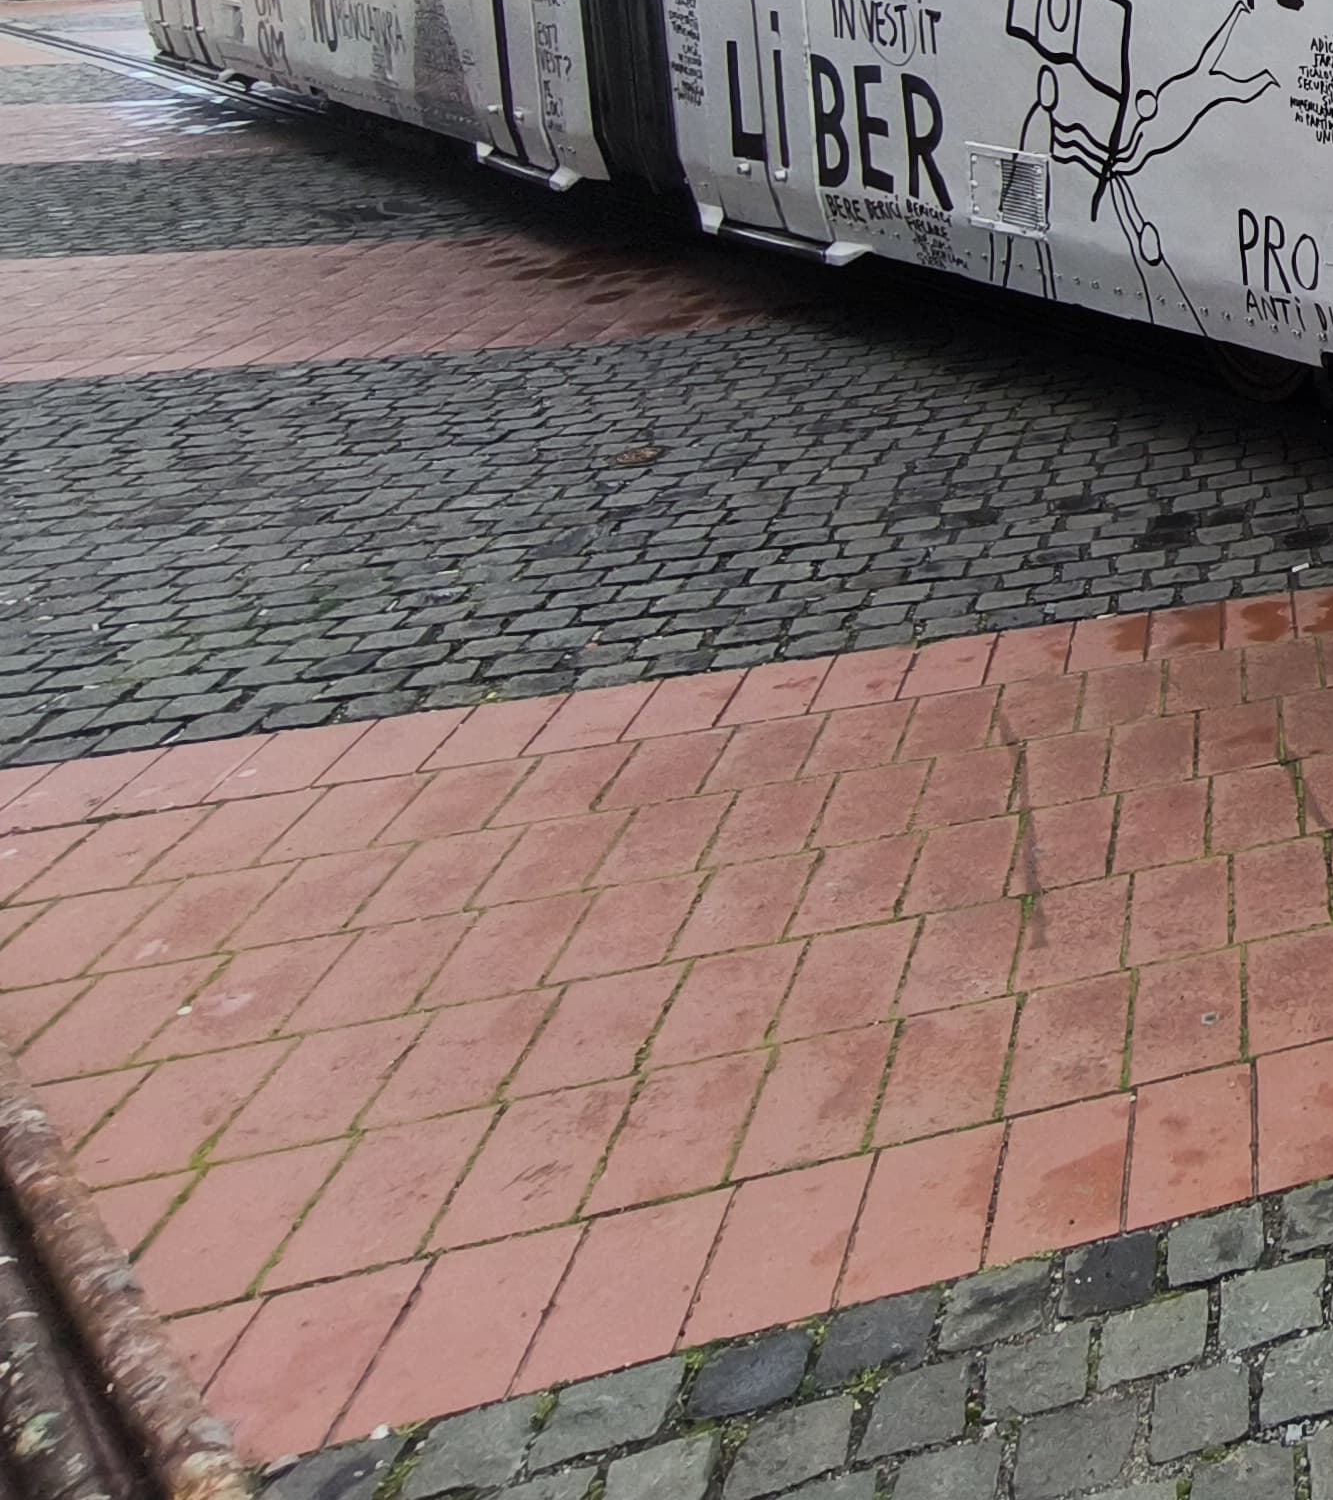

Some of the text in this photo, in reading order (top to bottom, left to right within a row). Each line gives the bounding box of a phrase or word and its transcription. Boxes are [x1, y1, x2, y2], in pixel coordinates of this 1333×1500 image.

[727, 11, 953, 211] LIBER
[1238, 208, 1319, 293] PRO
[1245, 288, 1306, 331] ANTI
